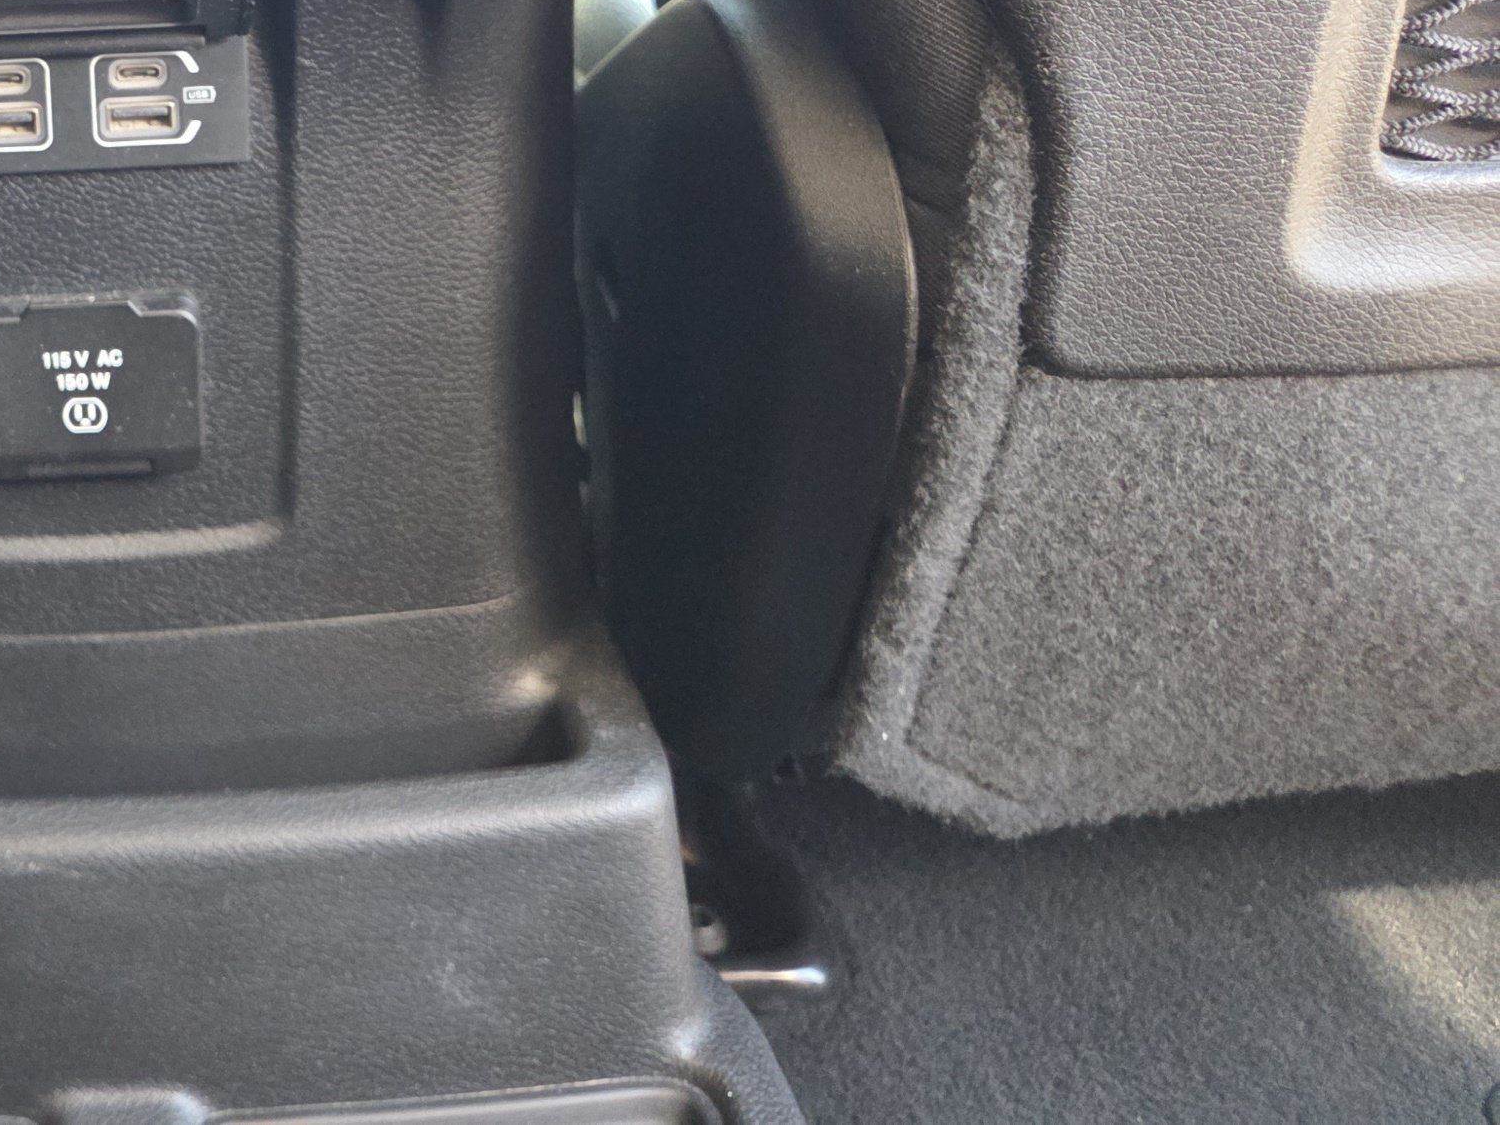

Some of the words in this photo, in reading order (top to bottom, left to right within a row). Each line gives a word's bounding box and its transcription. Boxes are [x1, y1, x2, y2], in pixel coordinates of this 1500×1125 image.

[41, 350, 72, 369] 115
[73, 350, 90, 368] V
[96, 348, 124, 368] AC
[56, 373, 89, 391] 150
[90, 372, 111, 390] W
